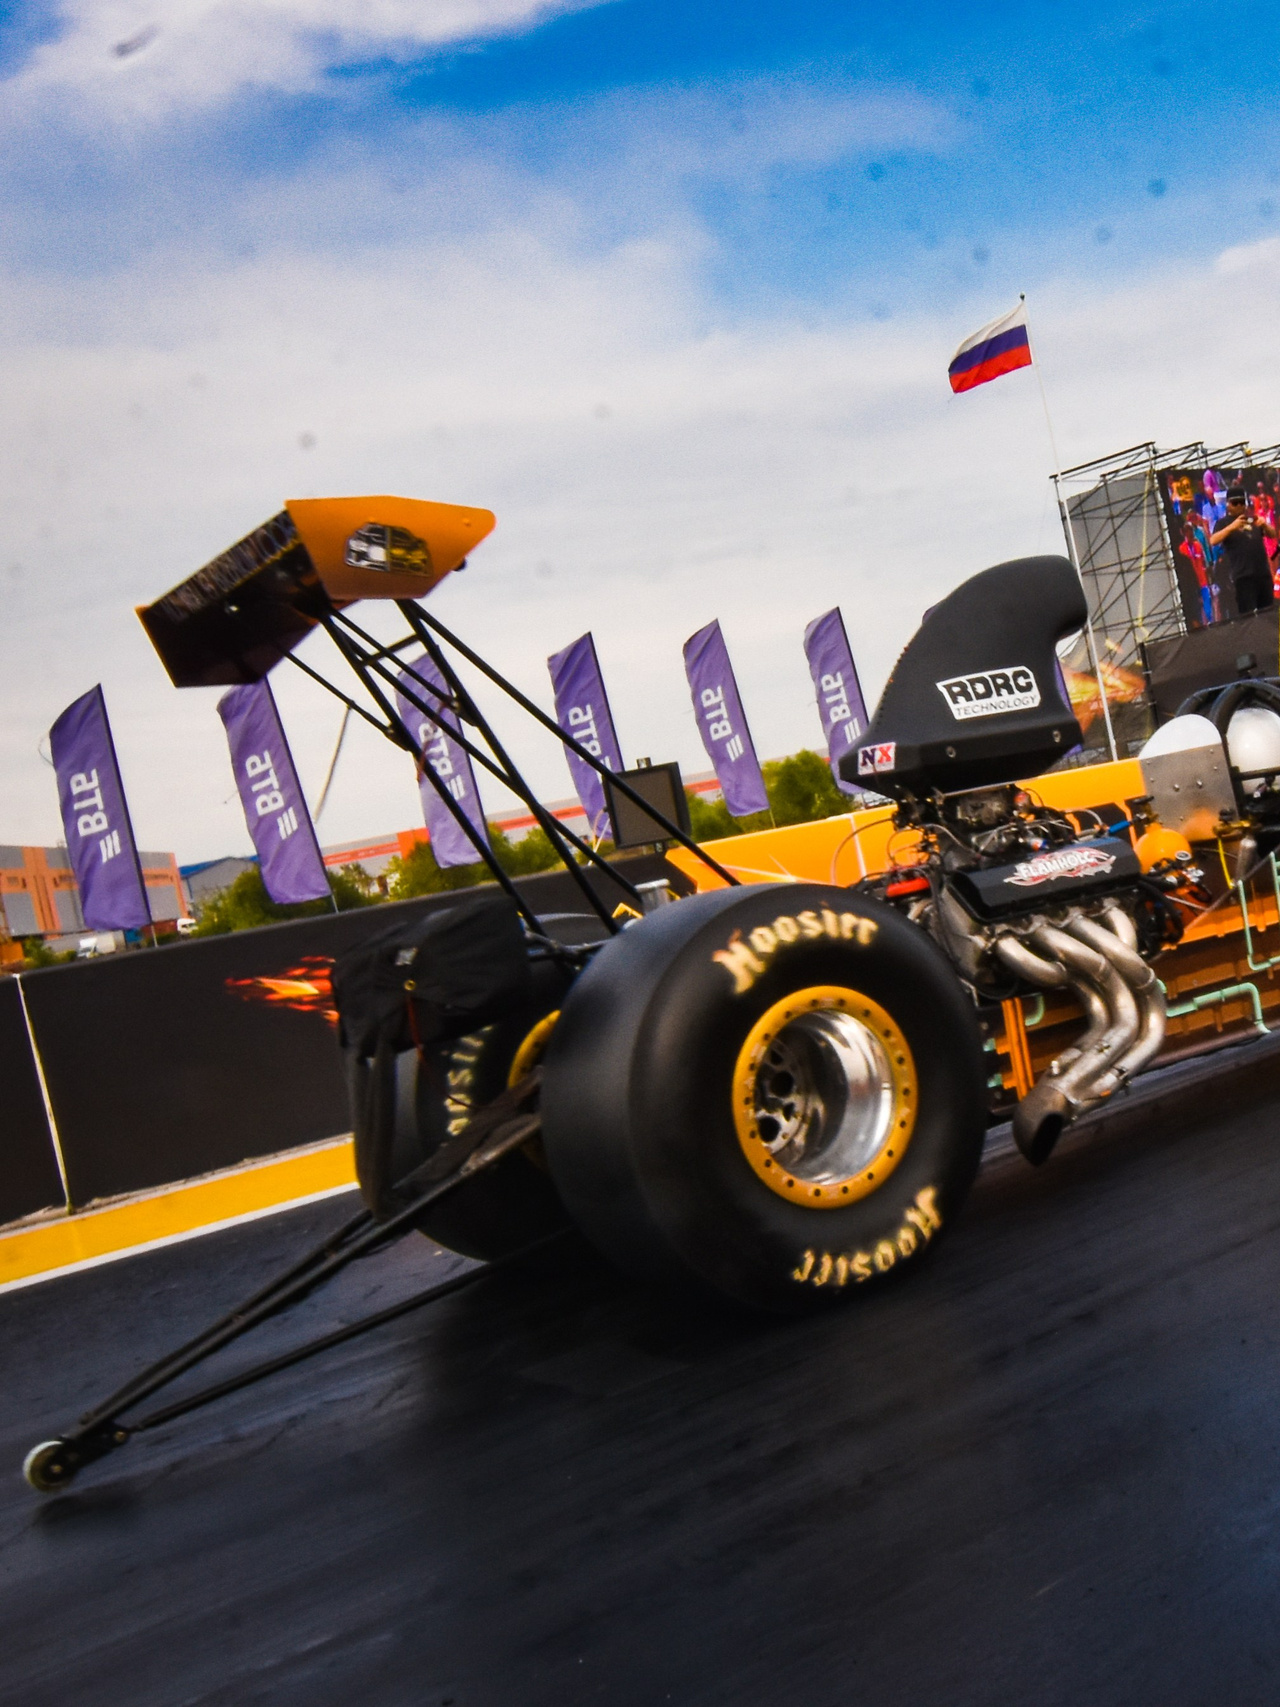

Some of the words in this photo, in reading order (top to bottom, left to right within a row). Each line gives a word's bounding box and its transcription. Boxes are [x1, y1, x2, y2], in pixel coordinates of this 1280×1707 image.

[942, 669, 1034, 705] RDRC
[955, 694, 1038, 716] TECHNOLOGY
[861, 745, 893, 767] NX
